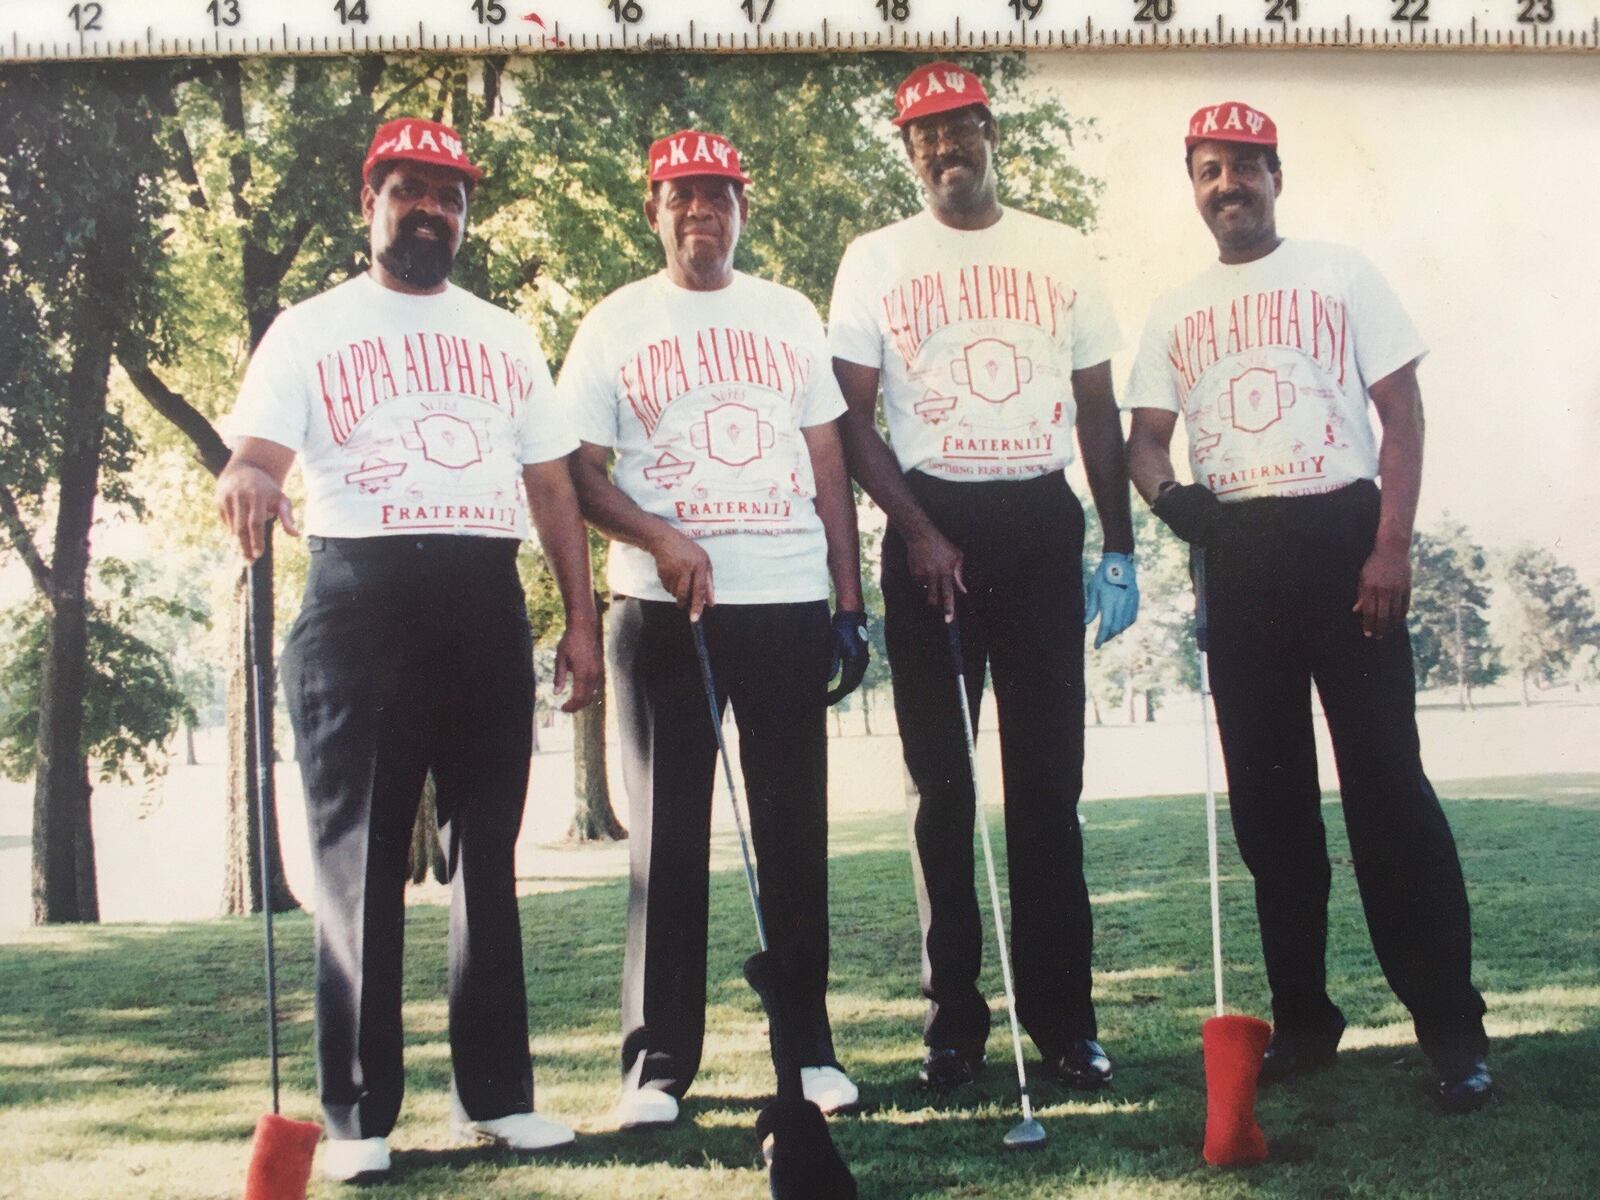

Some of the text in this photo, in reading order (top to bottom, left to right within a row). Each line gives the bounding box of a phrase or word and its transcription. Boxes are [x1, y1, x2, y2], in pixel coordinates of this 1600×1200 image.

[68, 0, 1554, 31] 12 13 14 15 16 17 18 19 20 21 22 23
[883, 271, 950, 371] KAPPA
[957, 265, 1041, 326] ALPHA
[1227, 288, 1302, 354] ALPHA
[1311, 289, 1348, 384] PSI
[316, 336, 399, 447] KAPPA
[403, 332, 501, 405] ALPHA
[620, 335, 691, 440] KAPPA
[697, 327, 784, 393] ALPHA
[942, 433, 1053, 452] FRATERNITY
[1207, 455, 1325, 490] FRATERNITY
[381, 505, 516, 526] FRATERNITY
[675, 500, 792, 518] FRATERNITY
